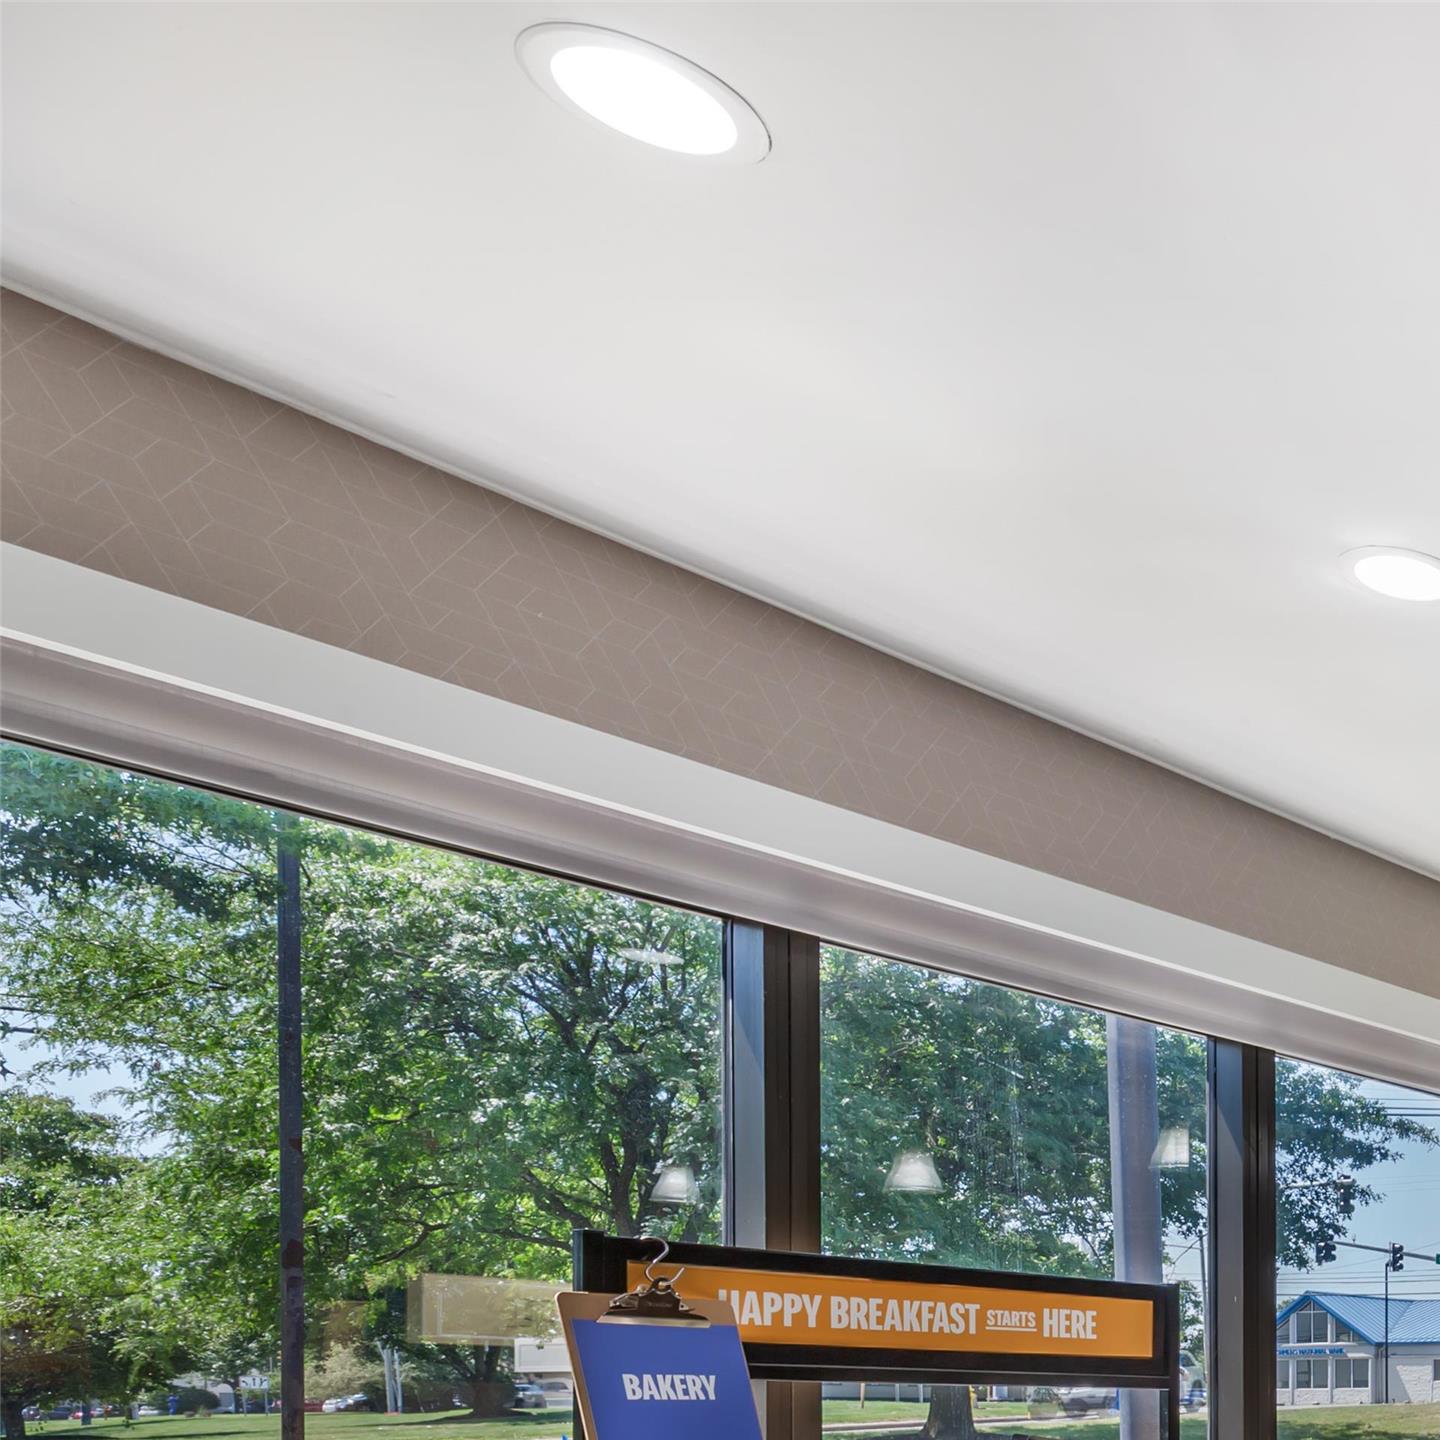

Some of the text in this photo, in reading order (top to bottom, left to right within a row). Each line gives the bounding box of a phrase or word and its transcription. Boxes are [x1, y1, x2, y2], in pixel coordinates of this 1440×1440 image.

[830, 1295, 981, 1335] BREAKFAST
[986, 1309, 1036, 1327] STARTS
[1043, 1307, 1097, 1340] HERE
[622, 1373, 717, 1400] BAKERY
